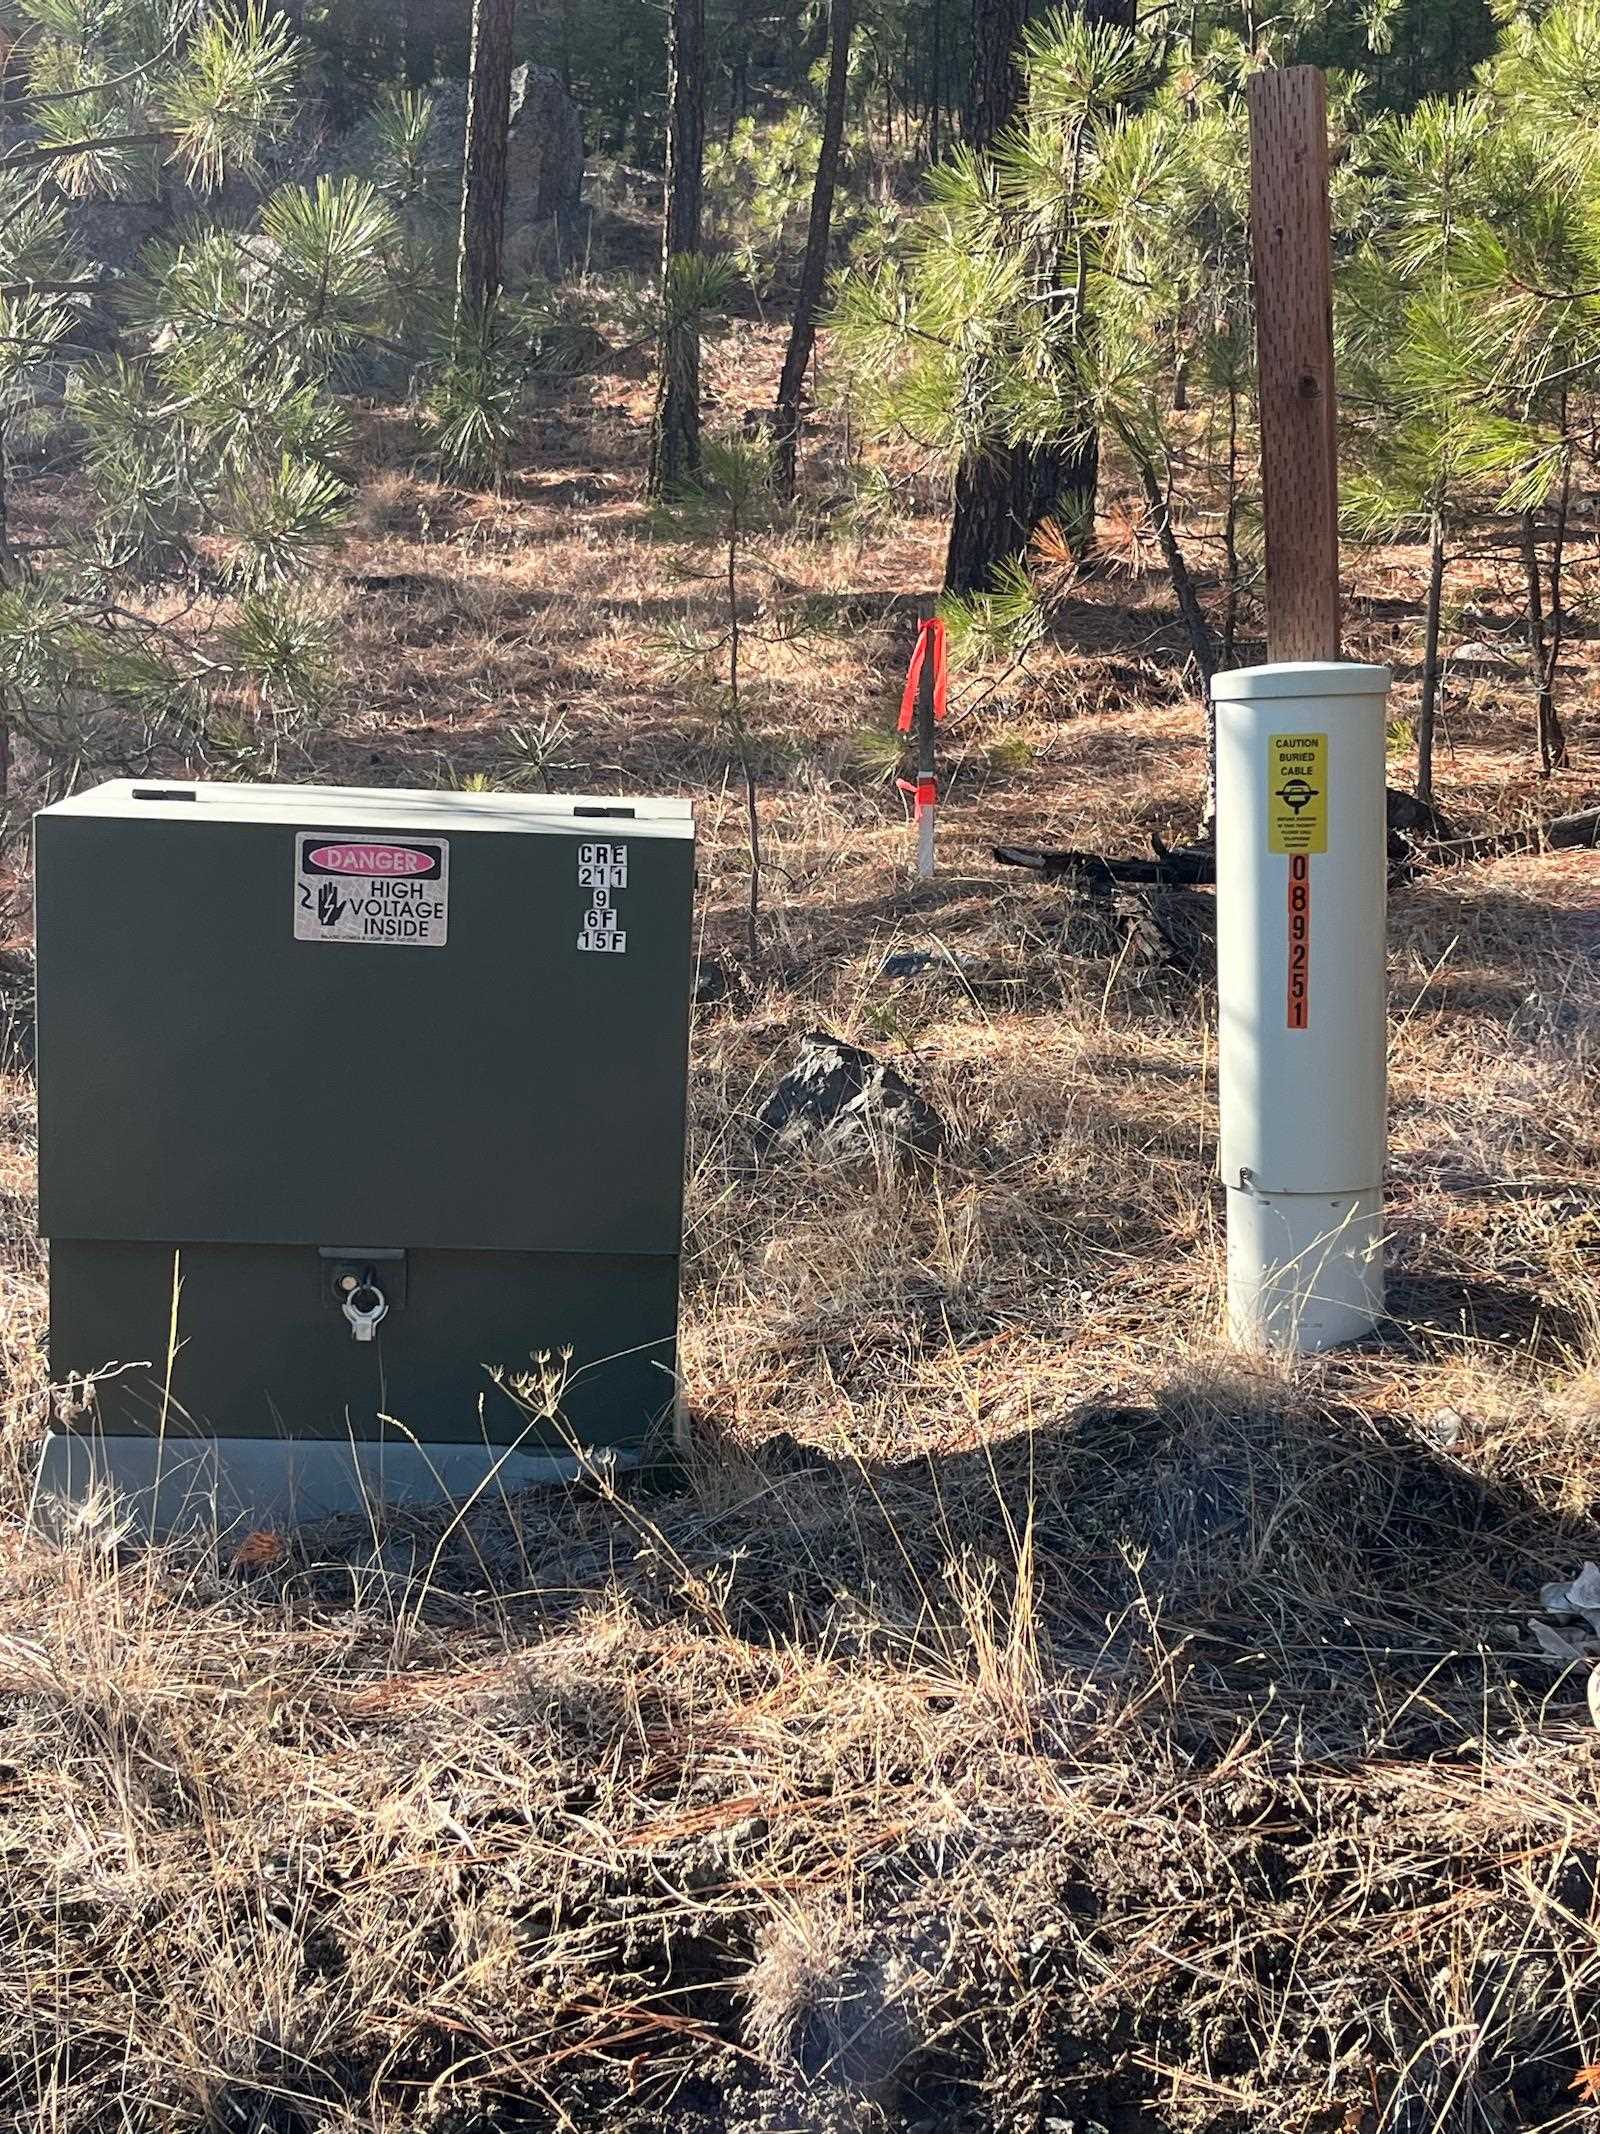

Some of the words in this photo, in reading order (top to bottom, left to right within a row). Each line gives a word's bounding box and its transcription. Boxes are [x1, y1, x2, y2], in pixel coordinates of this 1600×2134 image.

[1275, 739, 1319, 748] CAUTION
[1279, 753, 1315, 761] BURIED
[1280, 766, 1313, 776] CABLE
[327, 849, 418, 872] DANGER
[581, 845, 624, 864] CRE
[581, 868, 622, 886] 211
[371, 881, 423, 900] HIGH
[596, 890, 607, 907] 9
[350, 898, 444, 919] VOLTAGE
[364, 918, 429, 937] INSIDE
[587, 910, 614, 929] 6F
[582, 931, 624, 950] 15F
